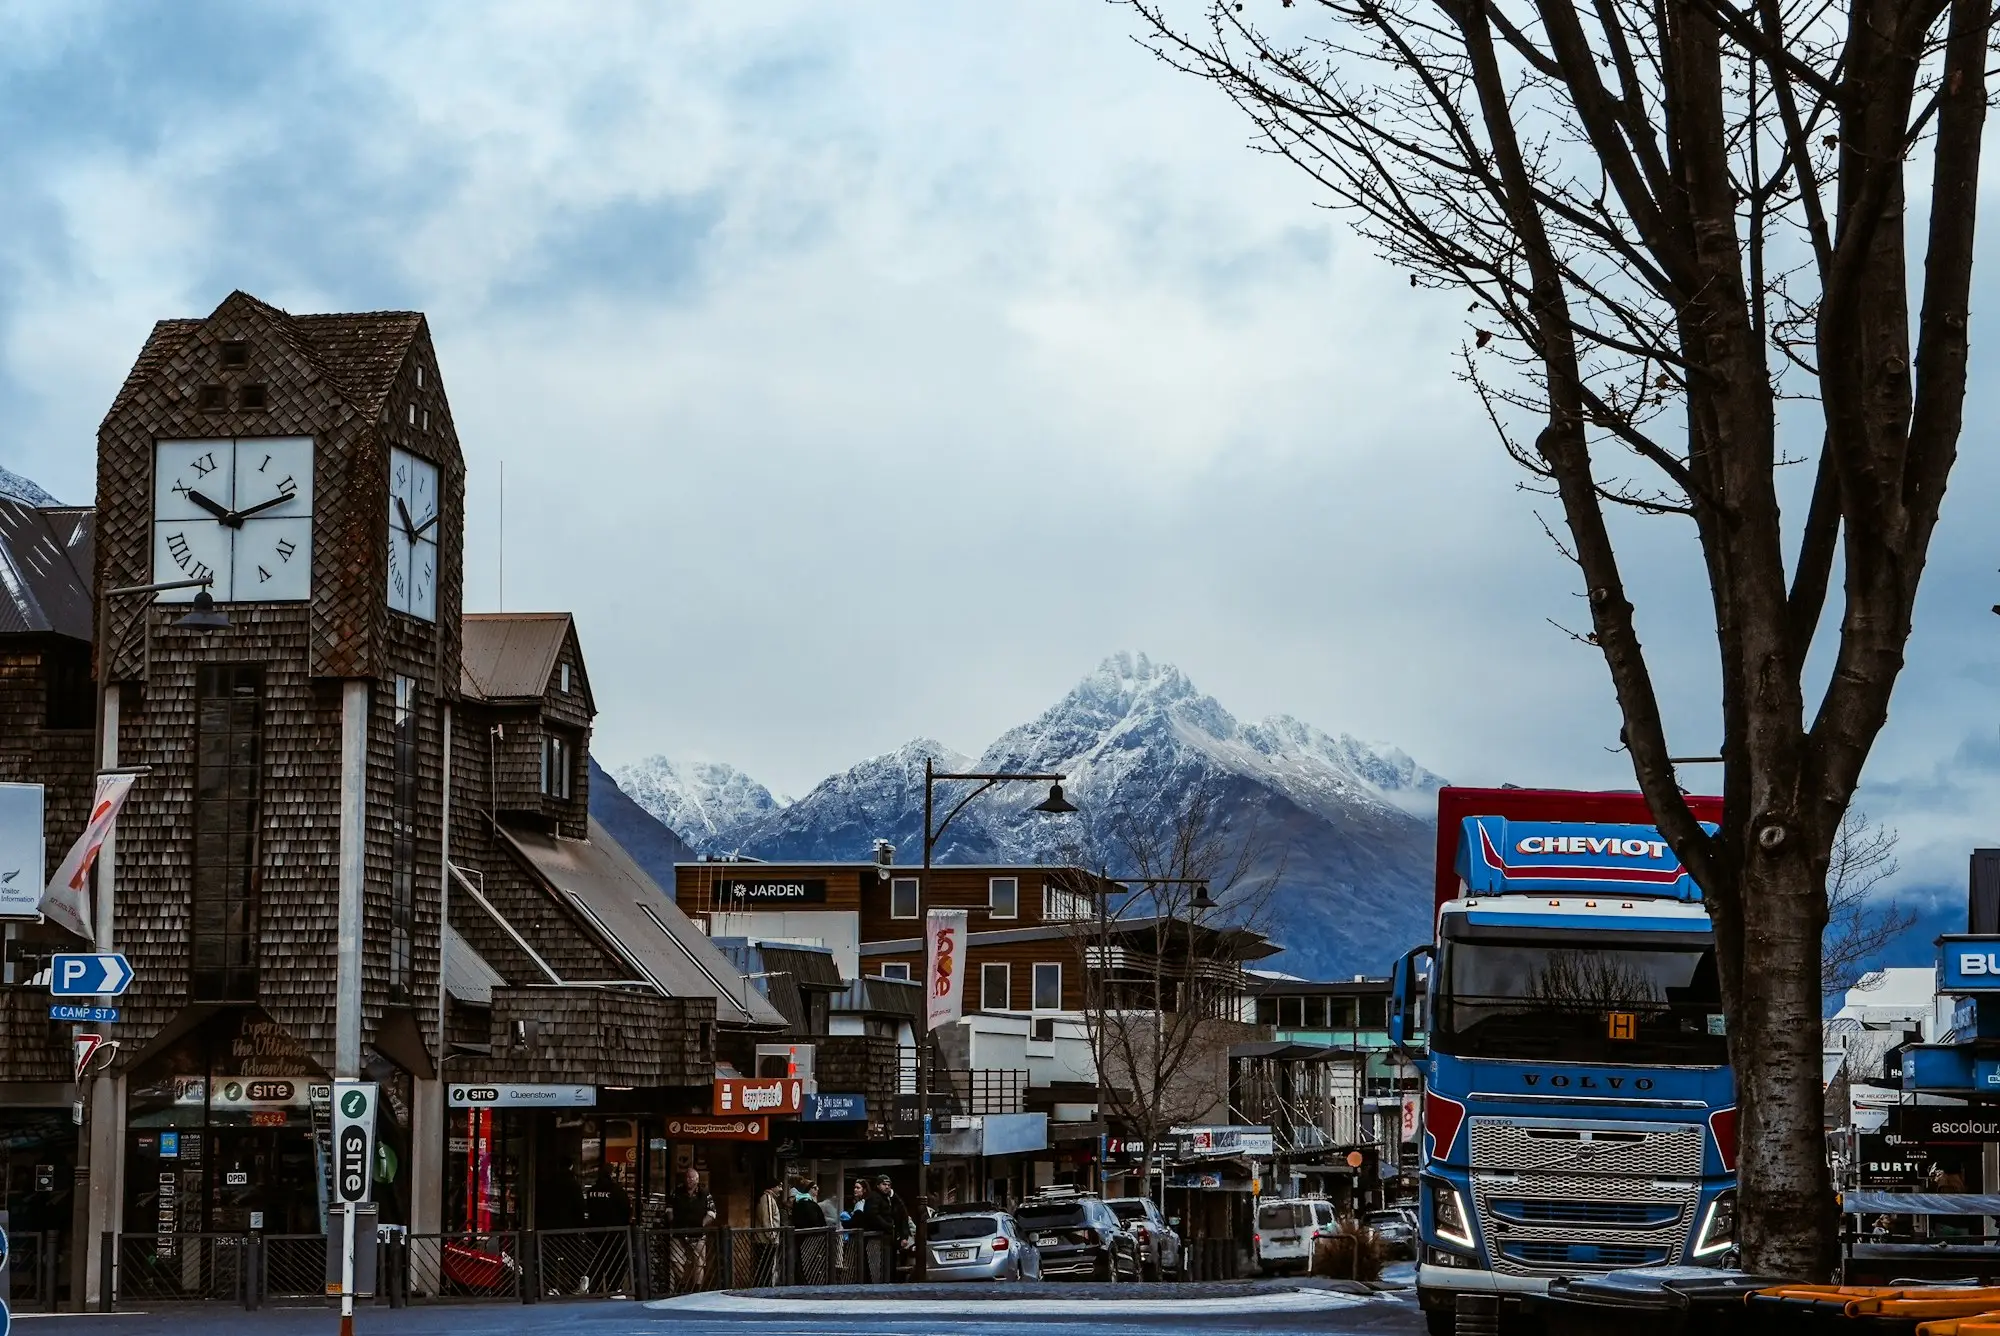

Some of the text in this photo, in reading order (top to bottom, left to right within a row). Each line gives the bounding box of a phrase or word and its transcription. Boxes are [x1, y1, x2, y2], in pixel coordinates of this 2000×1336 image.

[1518, 836, 1669, 859] CHEVIOT
[1, 887, 20, 895] Visitor
[749, 884, 804, 897] JARDEN
[1, 895, 35, 903] Information
[64, 960, 86, 989] P
[60, 1006, 108, 1019] CAMP ST
[1614, 1015, 1630, 1037] H
[232, 1039, 254, 1056] The
[240, 1057, 306, 1077] Adventure
[1523, 1074, 1655, 1091] VOLVO
[510, 1090, 557, 1100] Queenstown
[228, 1174, 246, 1183] OPEN
